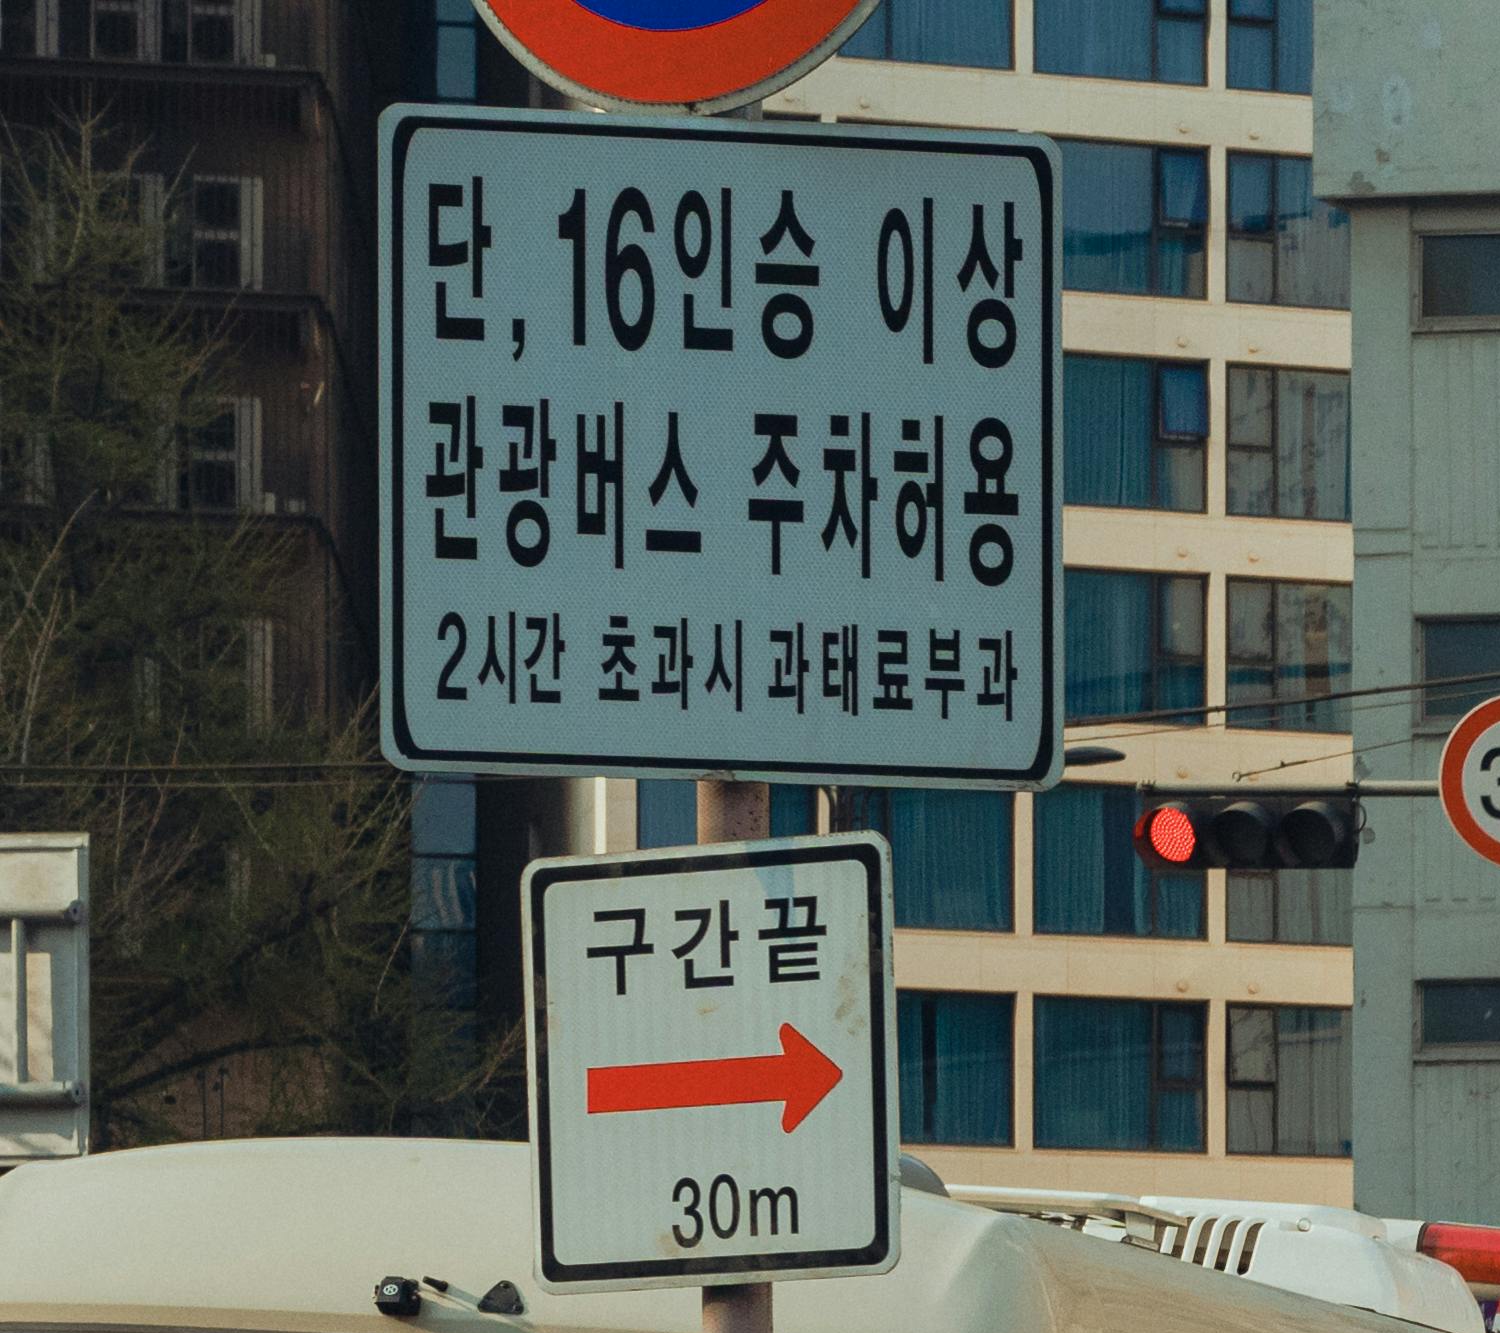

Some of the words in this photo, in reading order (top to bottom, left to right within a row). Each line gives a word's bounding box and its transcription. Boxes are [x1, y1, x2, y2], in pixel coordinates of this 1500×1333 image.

[877, 198, 1024, 369] 이상
[425, 397, 703, 571] 관광버스
[748, 412, 1020, 587] 주차허용
[436, 610, 566, 705] 2시간
[599, 616, 744, 713] 초과시
[767, 621, 1019, 722] 과태료부과
[586, 896, 828, 996] 구간끝
[671, 1173, 801, 1249] 30m
